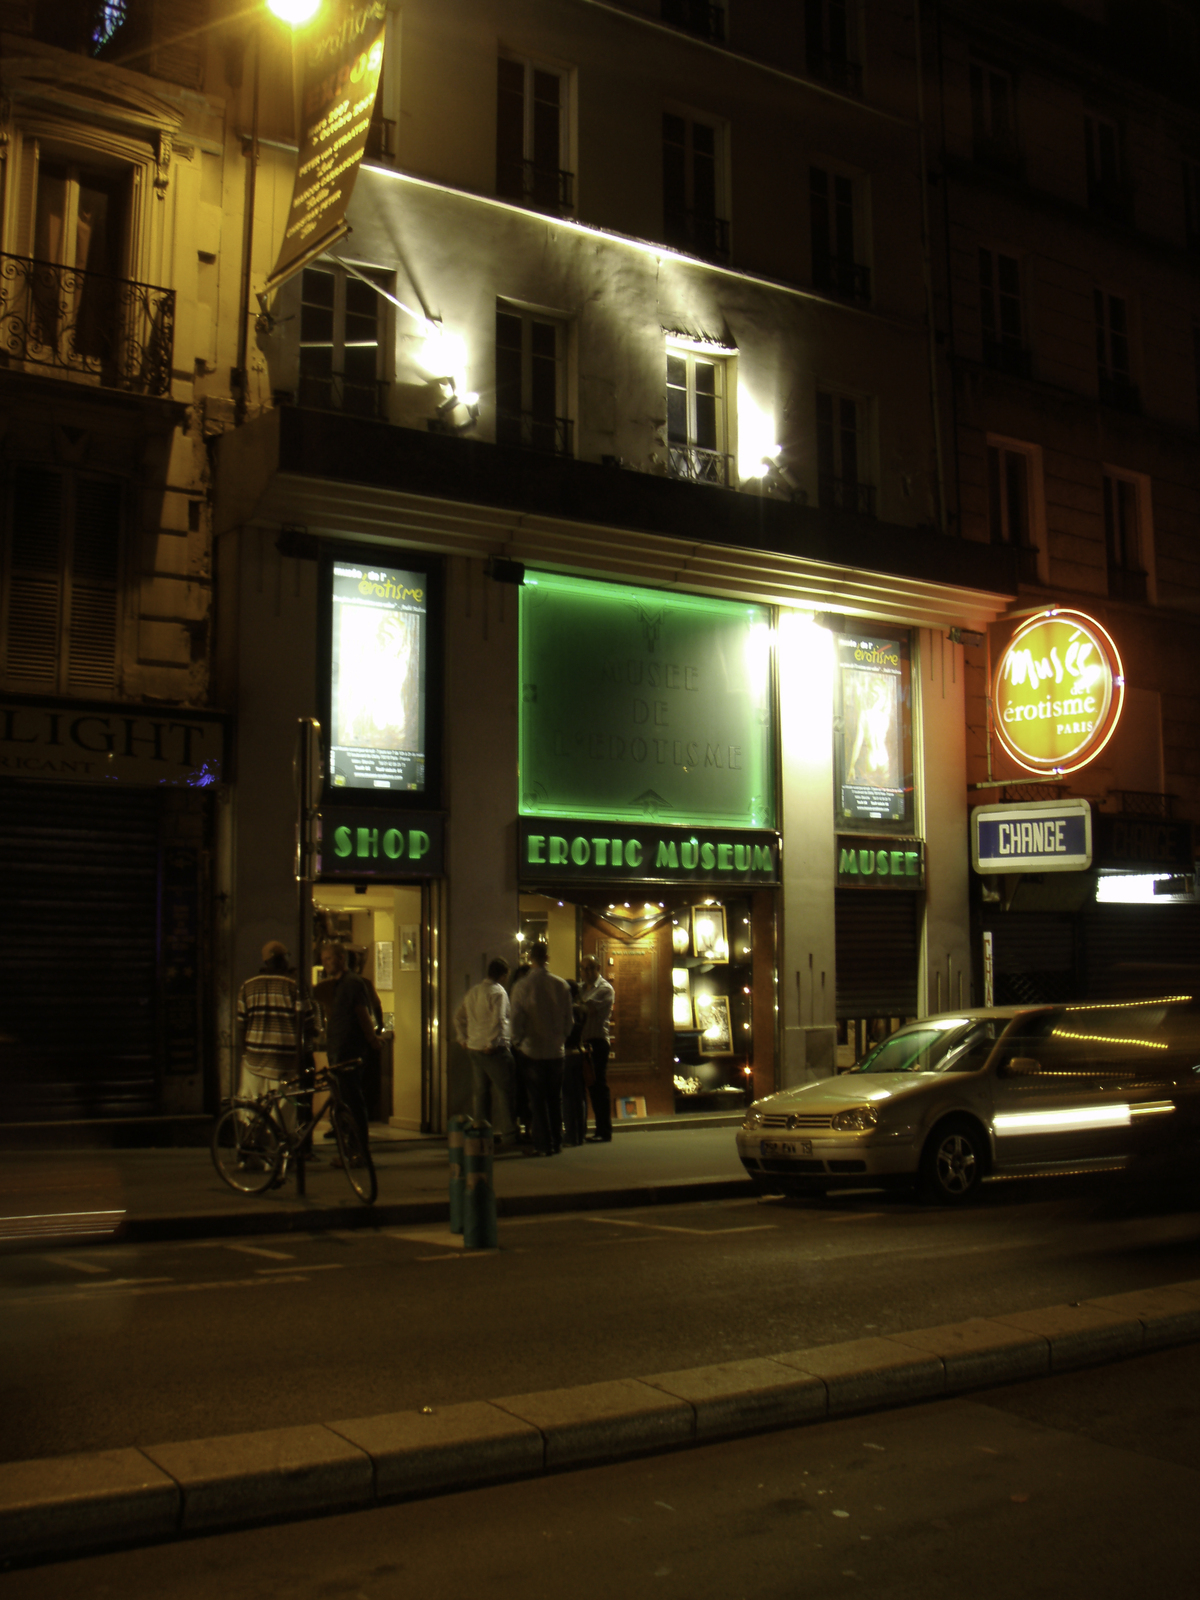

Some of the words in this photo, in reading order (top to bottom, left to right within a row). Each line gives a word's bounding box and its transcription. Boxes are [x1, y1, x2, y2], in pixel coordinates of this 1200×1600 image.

[358, 573, 424, 602] érotisme
[854, 643, 899, 666] érotisme
[602, 659, 699, 691] MUSEE
[633, 697, 669, 727] DE
[1003, 694, 1096, 723] érotisme
[0, 709, 204, 768] LIGHT
[1056, 720, 1094, 735] PARIS
[334, 825, 430, 860] SHOP
[998, 820, 1067, 855] CHANGE
[527, 835, 643, 868] EROTIC
[655, 839, 773, 872] MUSEUM
[838, 848, 919, 876] MUSEE
